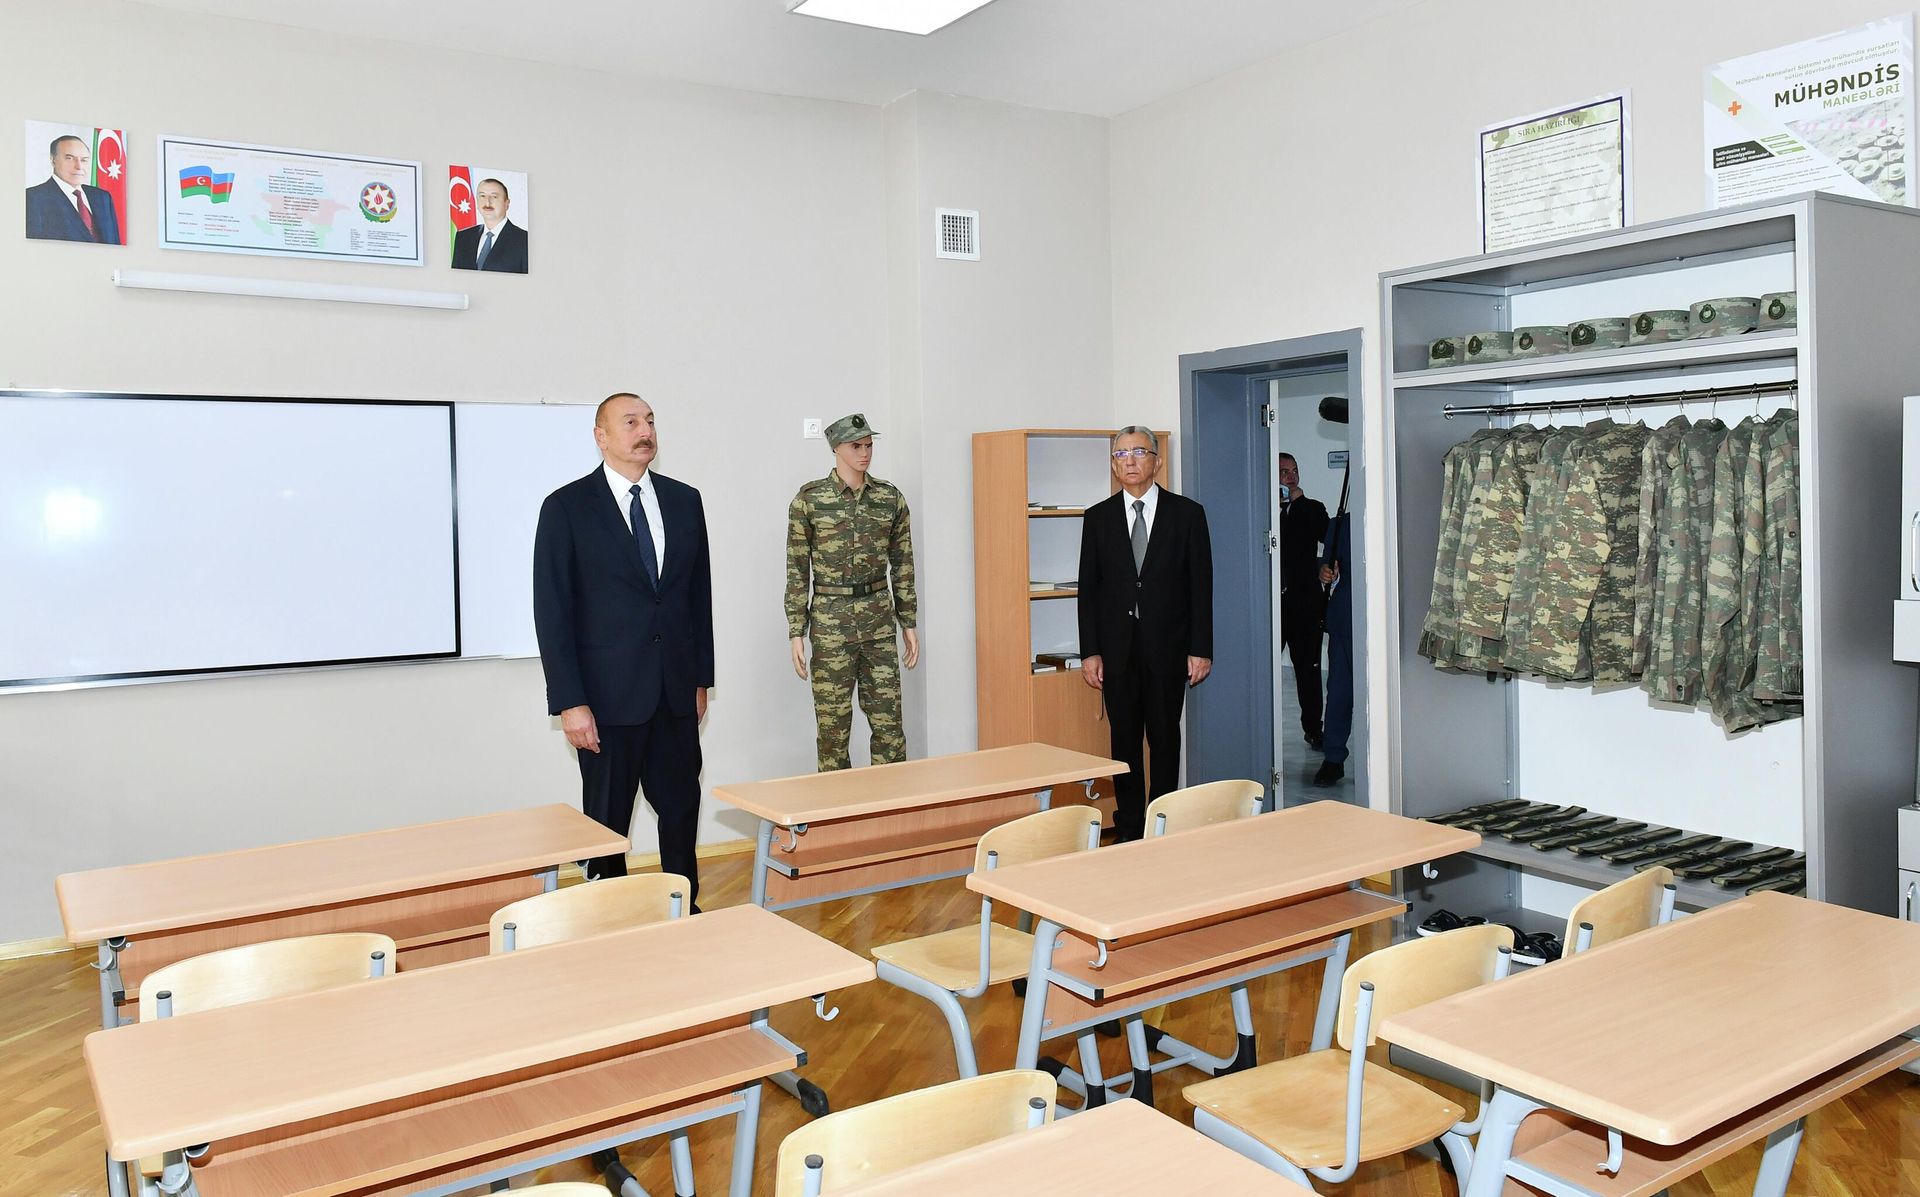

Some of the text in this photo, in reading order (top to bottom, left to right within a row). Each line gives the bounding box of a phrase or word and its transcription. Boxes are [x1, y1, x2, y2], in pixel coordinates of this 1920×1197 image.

[1774, 63, 1900, 108] MÜHƏNDİS
[1823, 81, 1900, 109] MANEƏLƏRİ
[1517, 114, 1580, 138] SIRA HAZIRLIĞI
